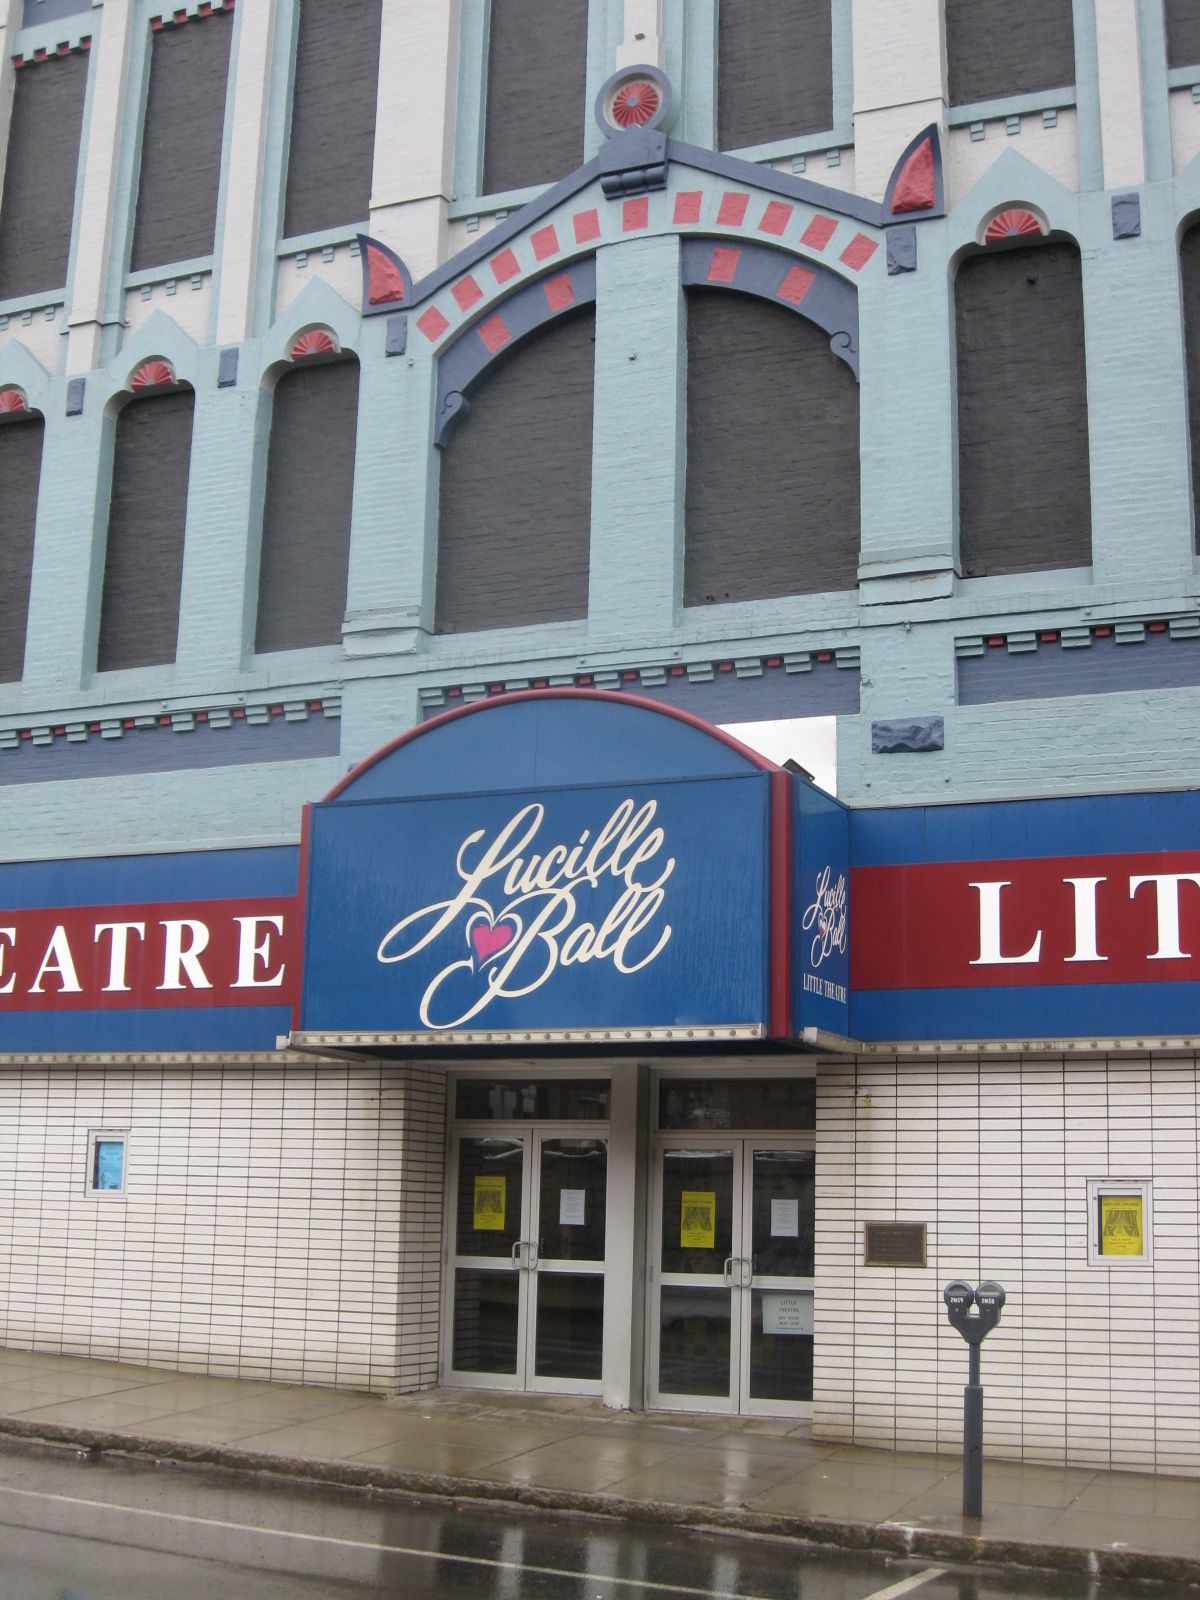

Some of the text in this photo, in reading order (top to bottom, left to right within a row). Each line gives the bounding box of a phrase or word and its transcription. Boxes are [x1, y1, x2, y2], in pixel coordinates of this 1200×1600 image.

[377, 799, 676, 963] Lucille
[802, 866, 846, 930] Lucille
[968, 873, 1200, 966] LIT
[419, 875, 672, 1029] Ball
[811, 907, 847, 967] Ball
[803, 972, 847, 1004] LITTLE THEATRE
